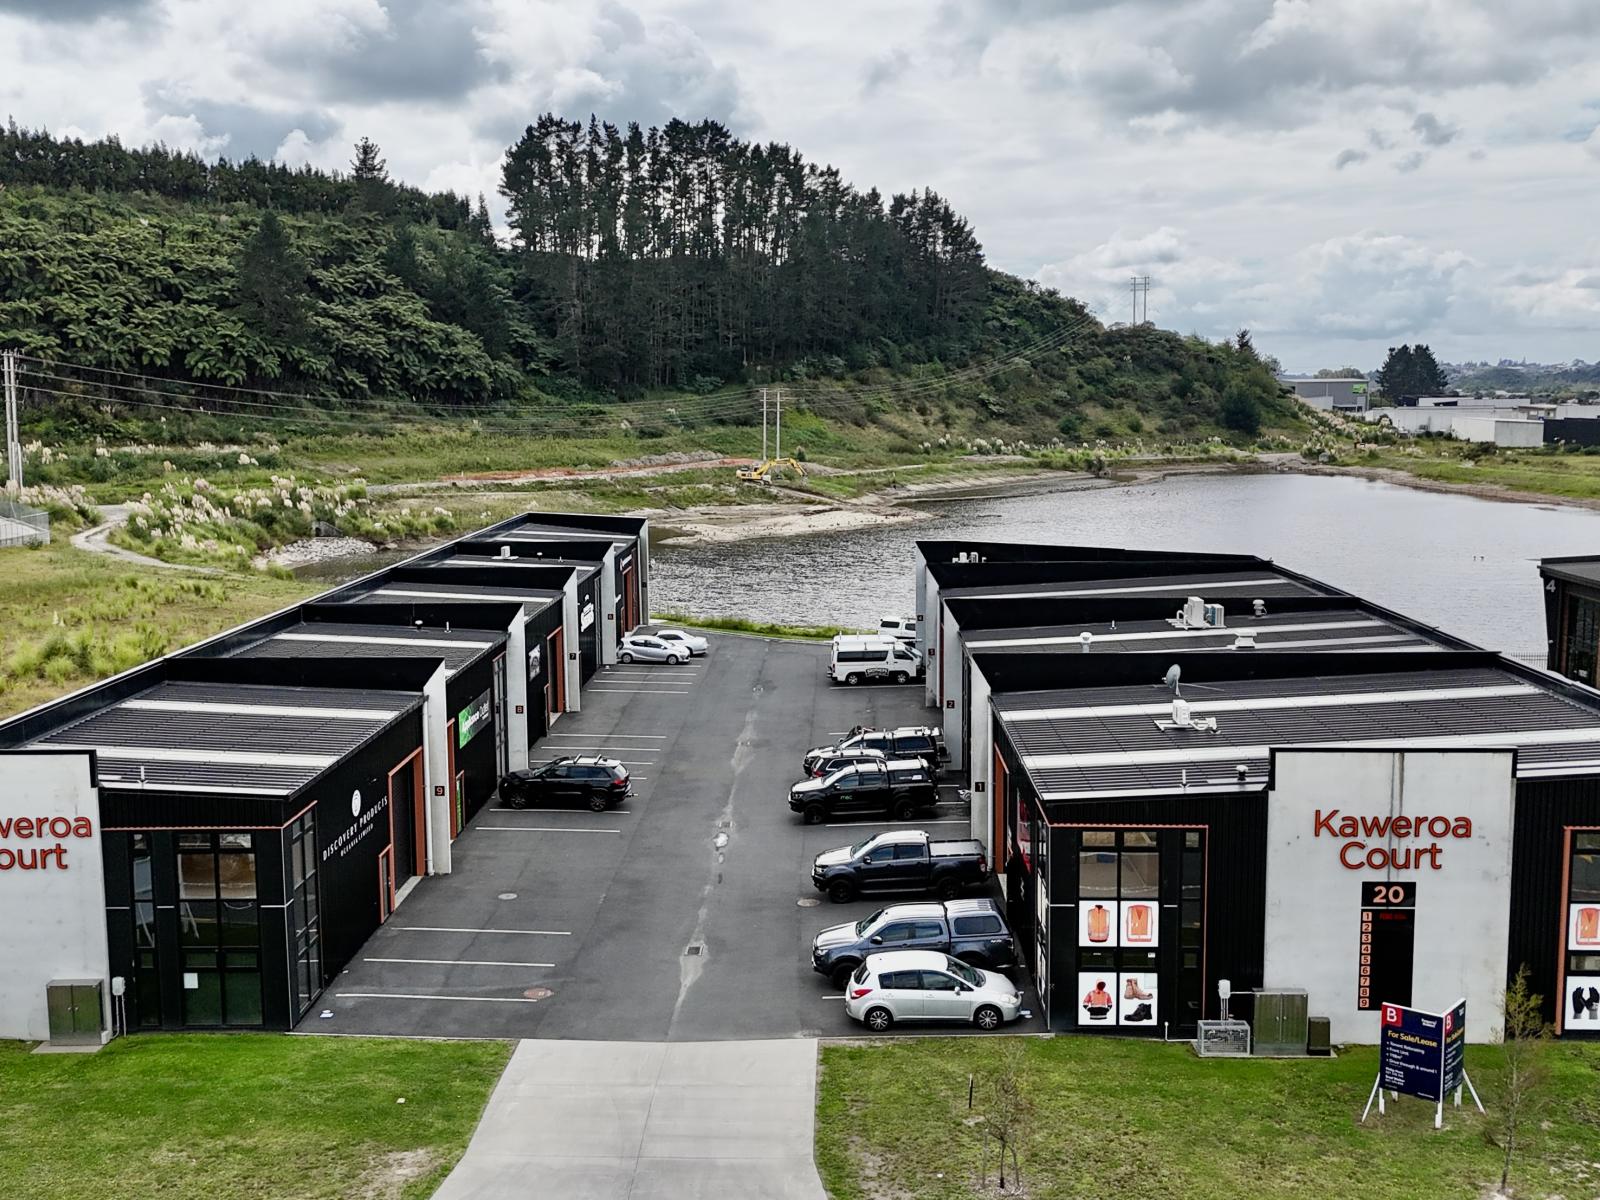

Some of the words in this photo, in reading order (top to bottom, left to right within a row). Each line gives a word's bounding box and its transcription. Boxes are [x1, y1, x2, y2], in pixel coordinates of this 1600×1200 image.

[1545, 579, 1556, 593] 4
[322, 823, 357, 861] DISCOVERY
[360, 795, 388, 828] PRODUCTS
[1314, 809, 1473, 839] Kaweroa
[1339, 841, 1443, 870] Court
[1373, 885, 1405, 904] 20
[1386, 1007, 1397, 1022] B
[1446, 1014, 1452, 1030] B
[1387, 1030, 1399, 1039] For
[1400, 1033, 1438, 1048] Sale/Lease
